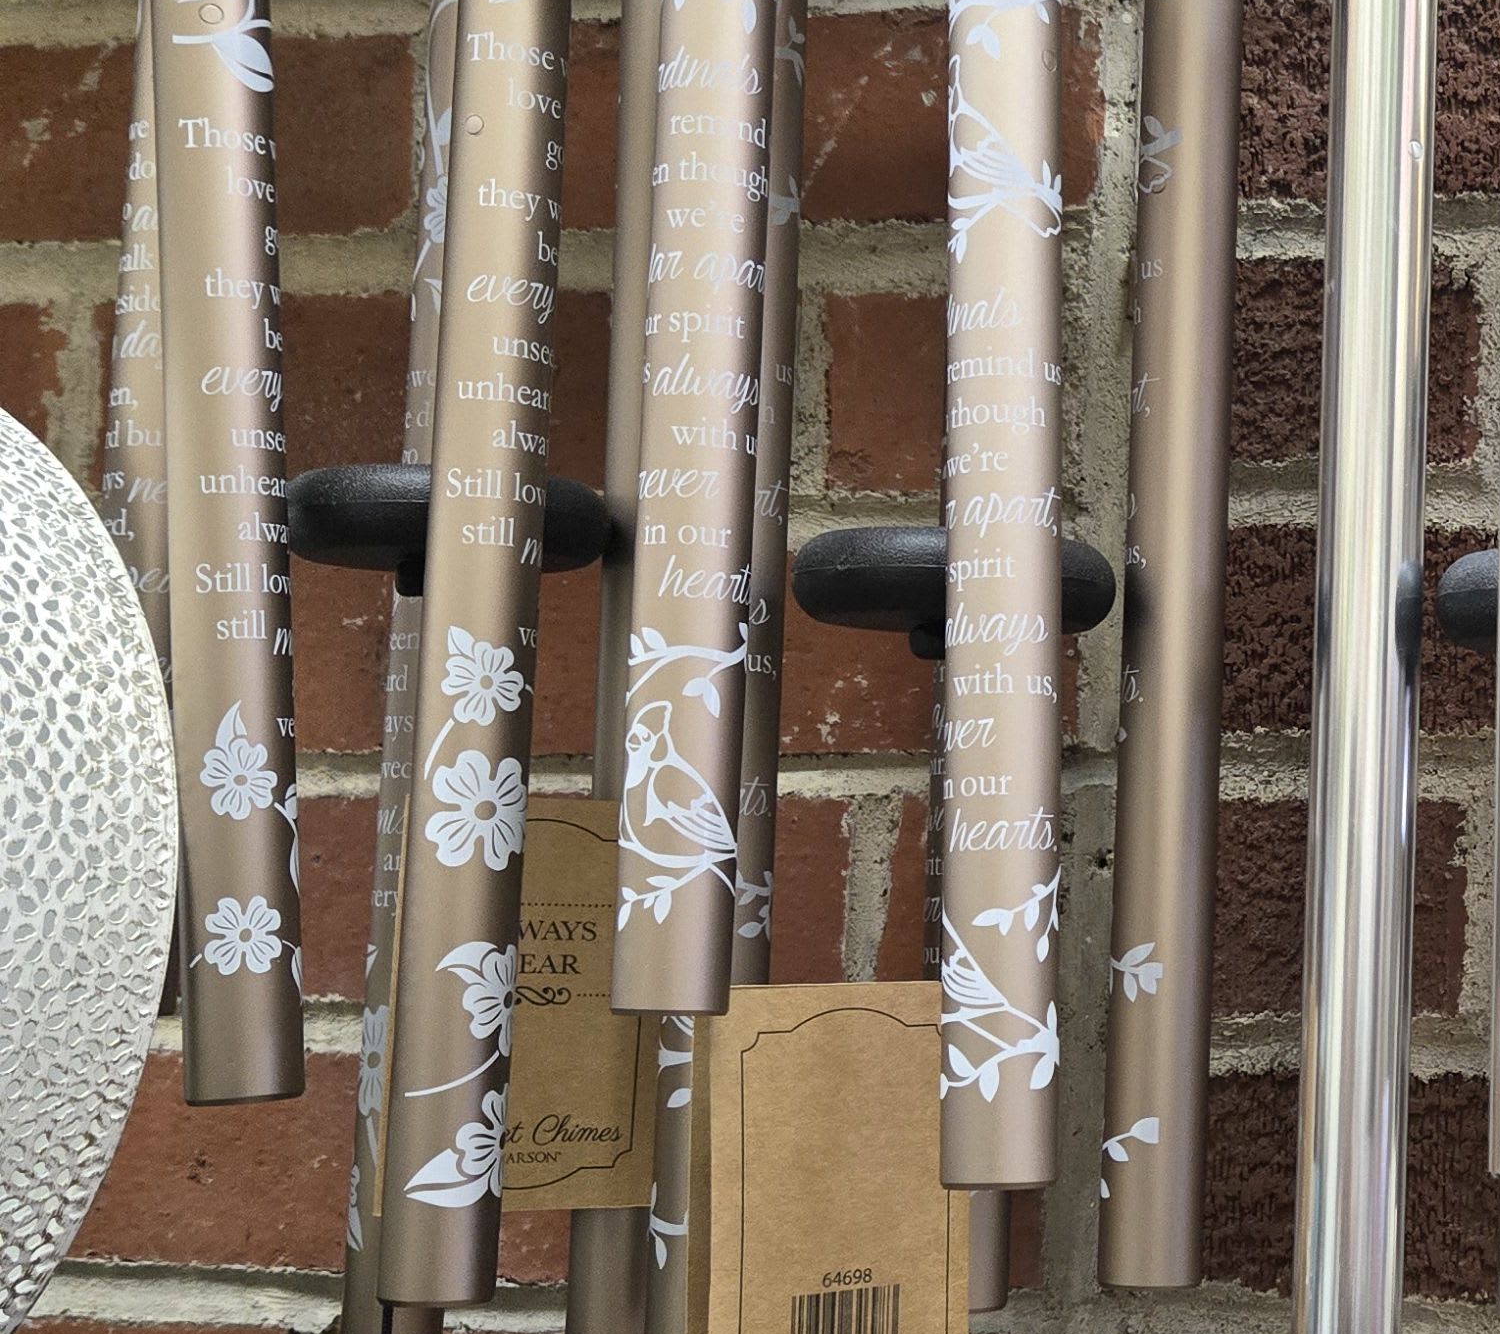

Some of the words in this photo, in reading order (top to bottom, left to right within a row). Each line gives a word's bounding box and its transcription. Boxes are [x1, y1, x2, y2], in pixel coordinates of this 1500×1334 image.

[467, 31, 555, 70] Those
[507, 78, 562, 119] love
[179, 117, 266, 155] Those
[225, 165, 275, 203] love
[478, 178, 541, 221] they
[205, 267, 264, 309] they
[467, 273, 555, 324] every
[668, 306, 746, 343] spirit
[653, 354, 760, 414] always
[947, 346, 1035, 385] remind
[1043, 360, 1062, 386] us
[201, 367, 283, 412] every
[951, 395, 1047, 435] though
[671, 418, 738, 452] with
[947, 442, 1009, 478] we're
[446, 468, 502, 499] Still
[963, 486, 1061, 538] apart,
[462, 517, 515, 547] still
[643, 515, 667, 546] in
[678, 523, 732, 548] our
[196, 563, 253, 594] Still
[948, 547, 1017, 593] spirit
[217, 609, 268, 641] still
[953, 662, 1015, 697] with
[1026, 673, 1057, 704] us,
[960, 774, 1013, 797] our
[948, 806, 1058, 853] hearts.
[533, 1114, 622, 1146] Chimes
[822, 1268, 872, 1288] 64698
